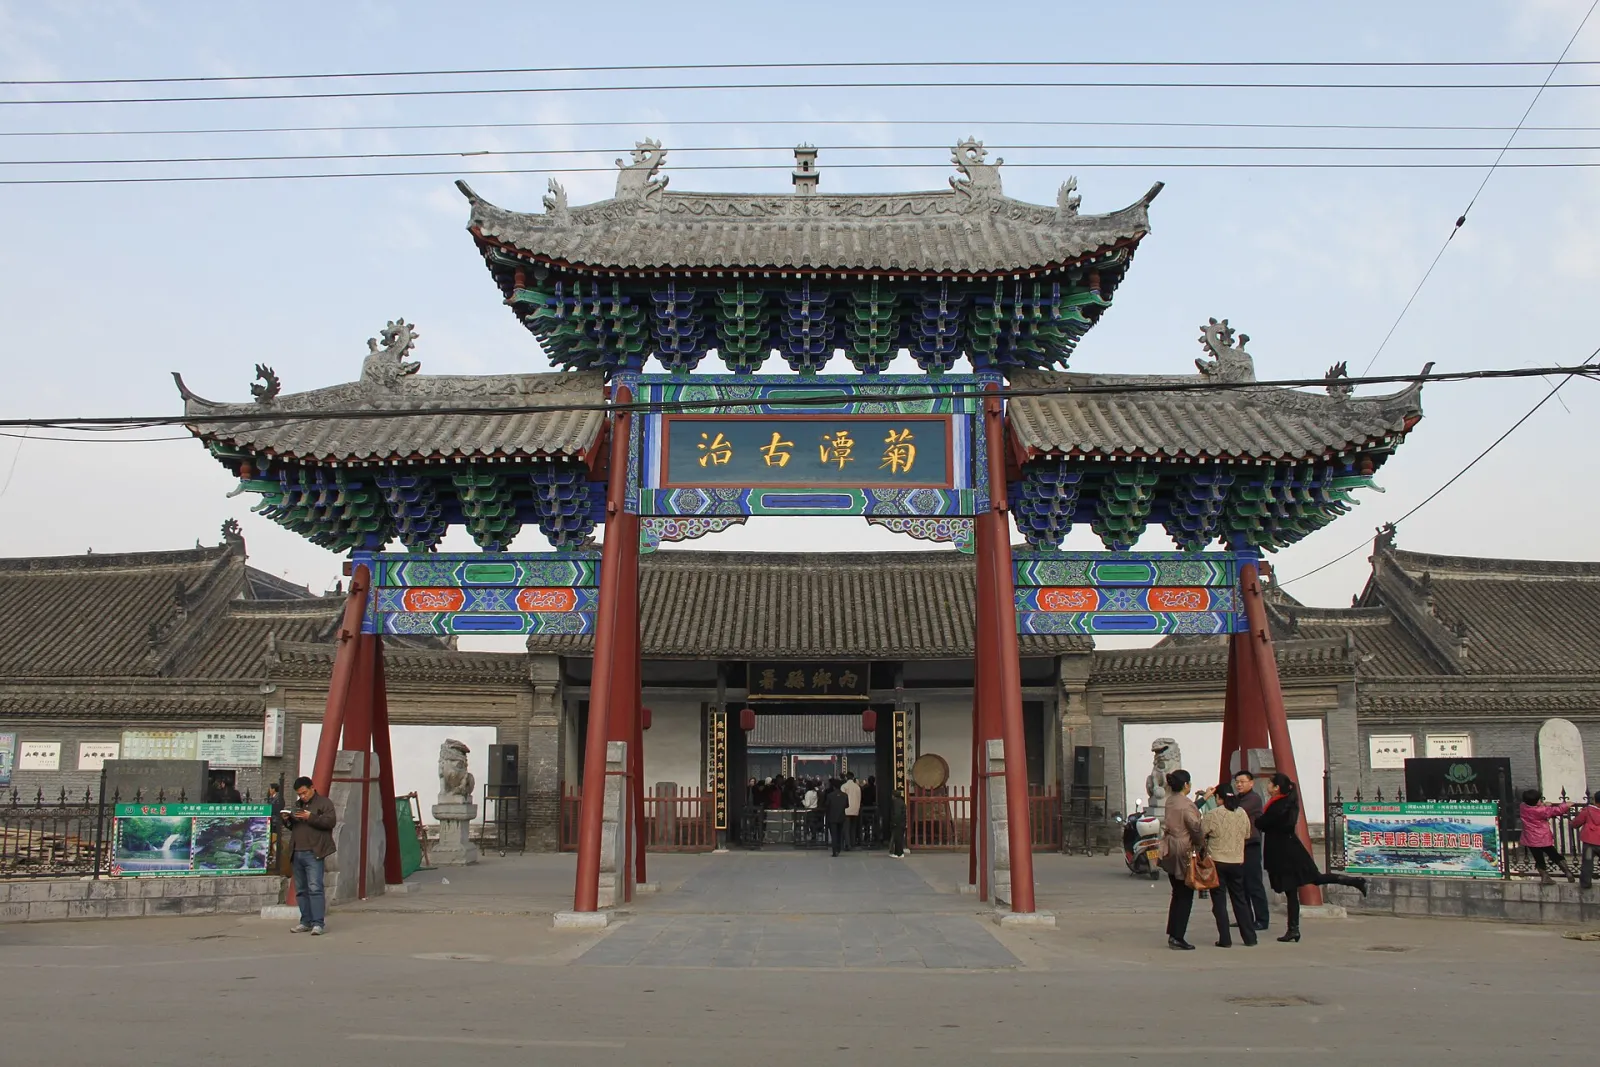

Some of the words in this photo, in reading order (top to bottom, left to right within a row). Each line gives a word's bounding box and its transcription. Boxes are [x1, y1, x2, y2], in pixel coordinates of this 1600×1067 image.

[697, 428, 917, 475] 菊潭古治
[1360, 831, 1484, 849] 宝天曼峡谷漂流欢迎您
